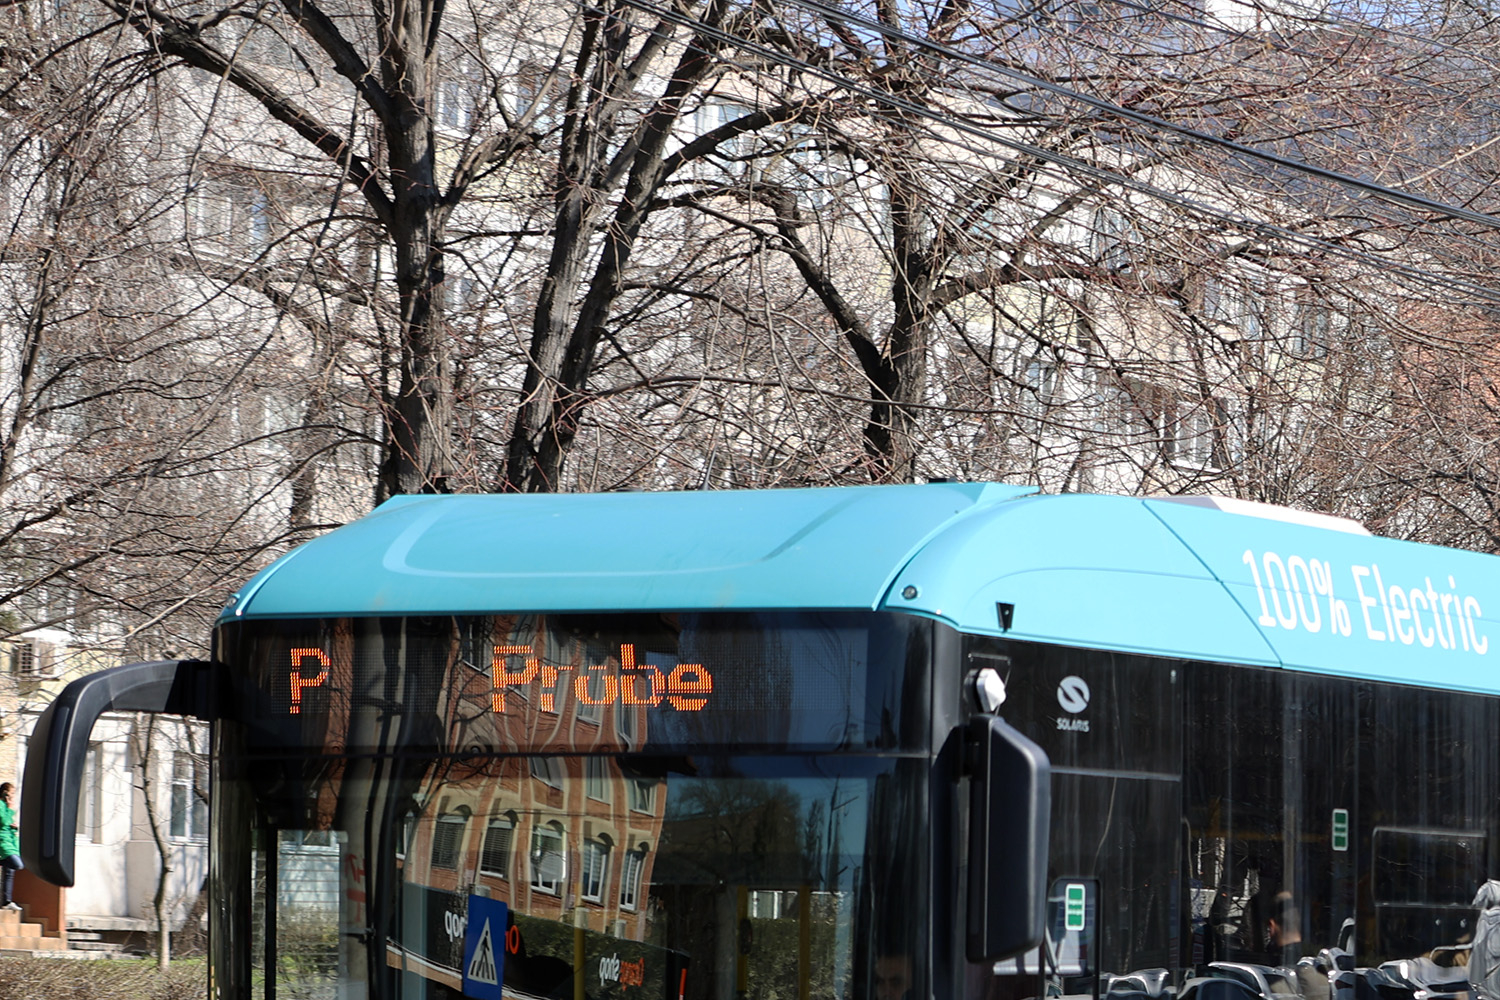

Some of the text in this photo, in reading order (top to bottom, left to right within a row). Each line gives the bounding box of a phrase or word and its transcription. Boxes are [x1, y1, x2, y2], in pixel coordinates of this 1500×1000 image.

[1243, 549, 1352, 637] 100%
[1351, 564, 1488, 655] Electric
[289, 643, 714, 714] P Probe
[1056, 717, 1090, 733] SOLARIS
